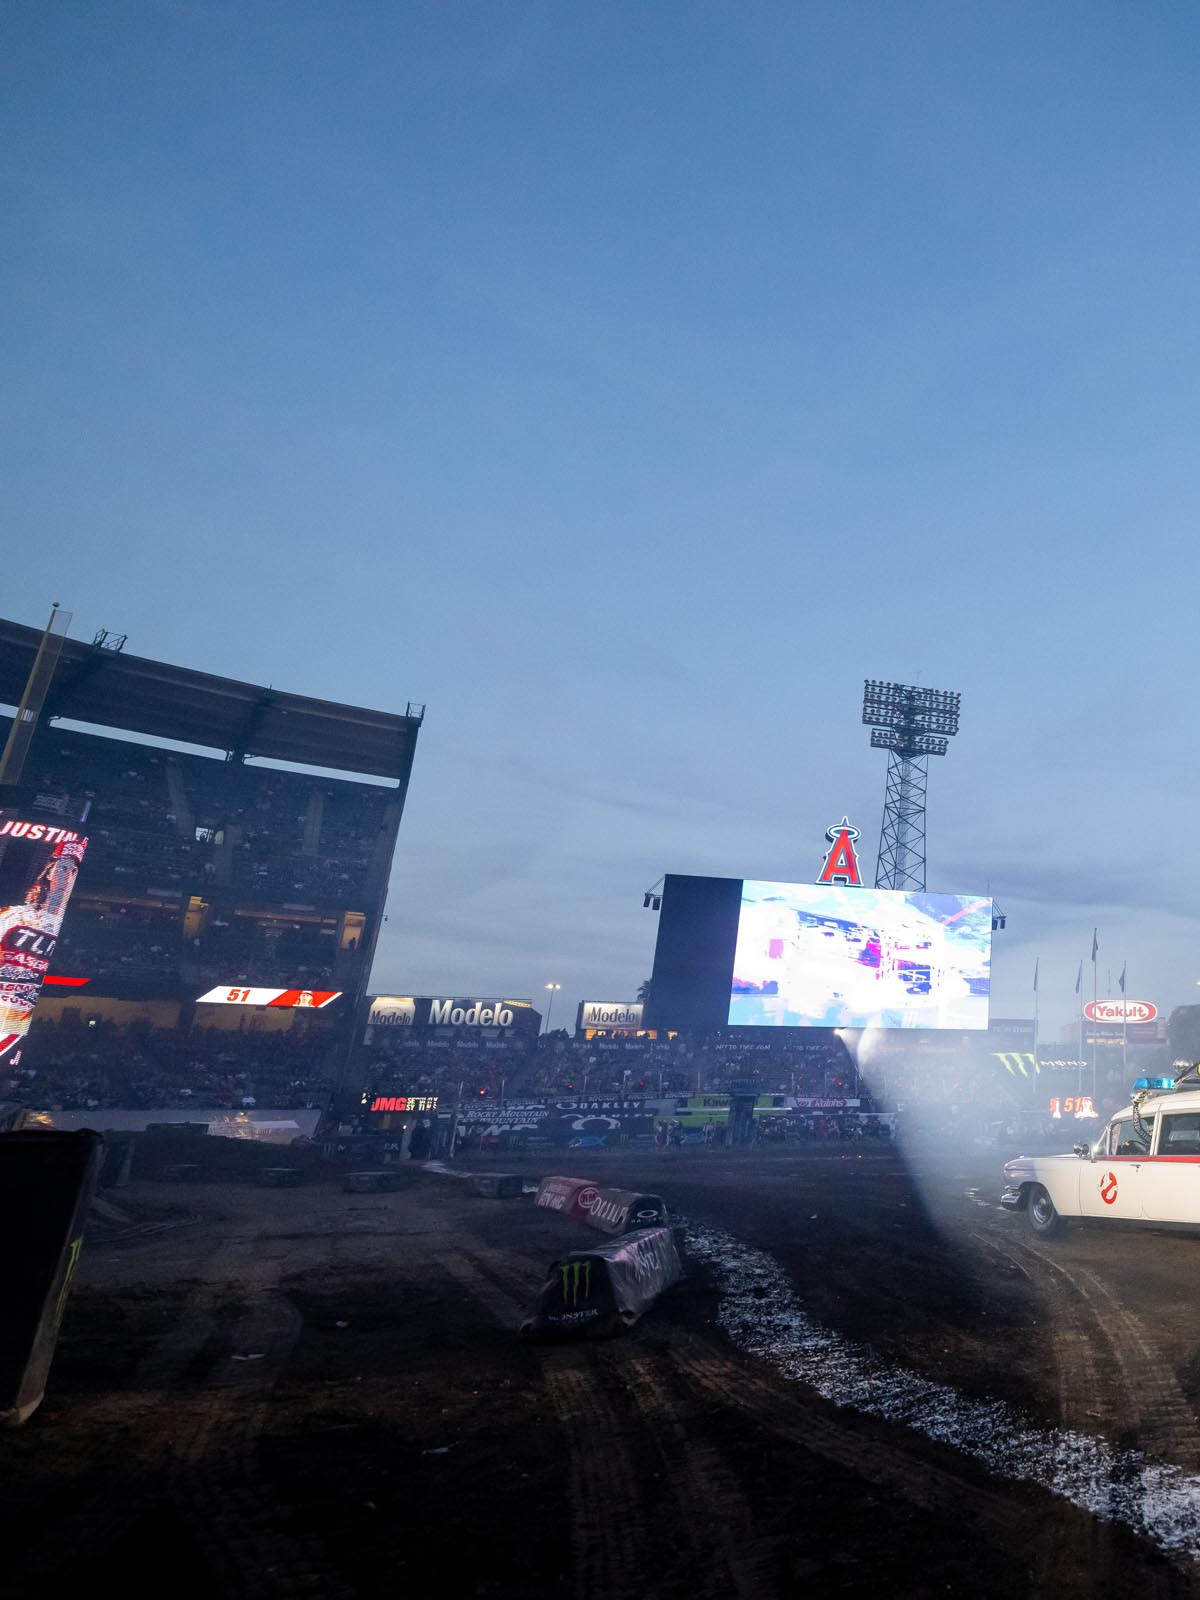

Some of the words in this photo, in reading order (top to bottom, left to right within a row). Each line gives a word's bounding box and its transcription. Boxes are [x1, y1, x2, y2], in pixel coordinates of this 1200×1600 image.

[0, 821, 78, 843] JUSTIN
[227, 989, 251, 1003] 51
[370, 1010, 411, 1025] Modelo
[428, 999, 514, 1027] Modelo
[590, 1007, 636, 1023] Modelo
[1097, 1005, 1148, 1018] Yakult
[371, 1097, 407, 1112] JMG
[579, 1101, 642, 1109] OAKLEY
[466, 1110, 499, 1118] ROCKY
[499, 1110, 550, 1118] MOUNTAIN
